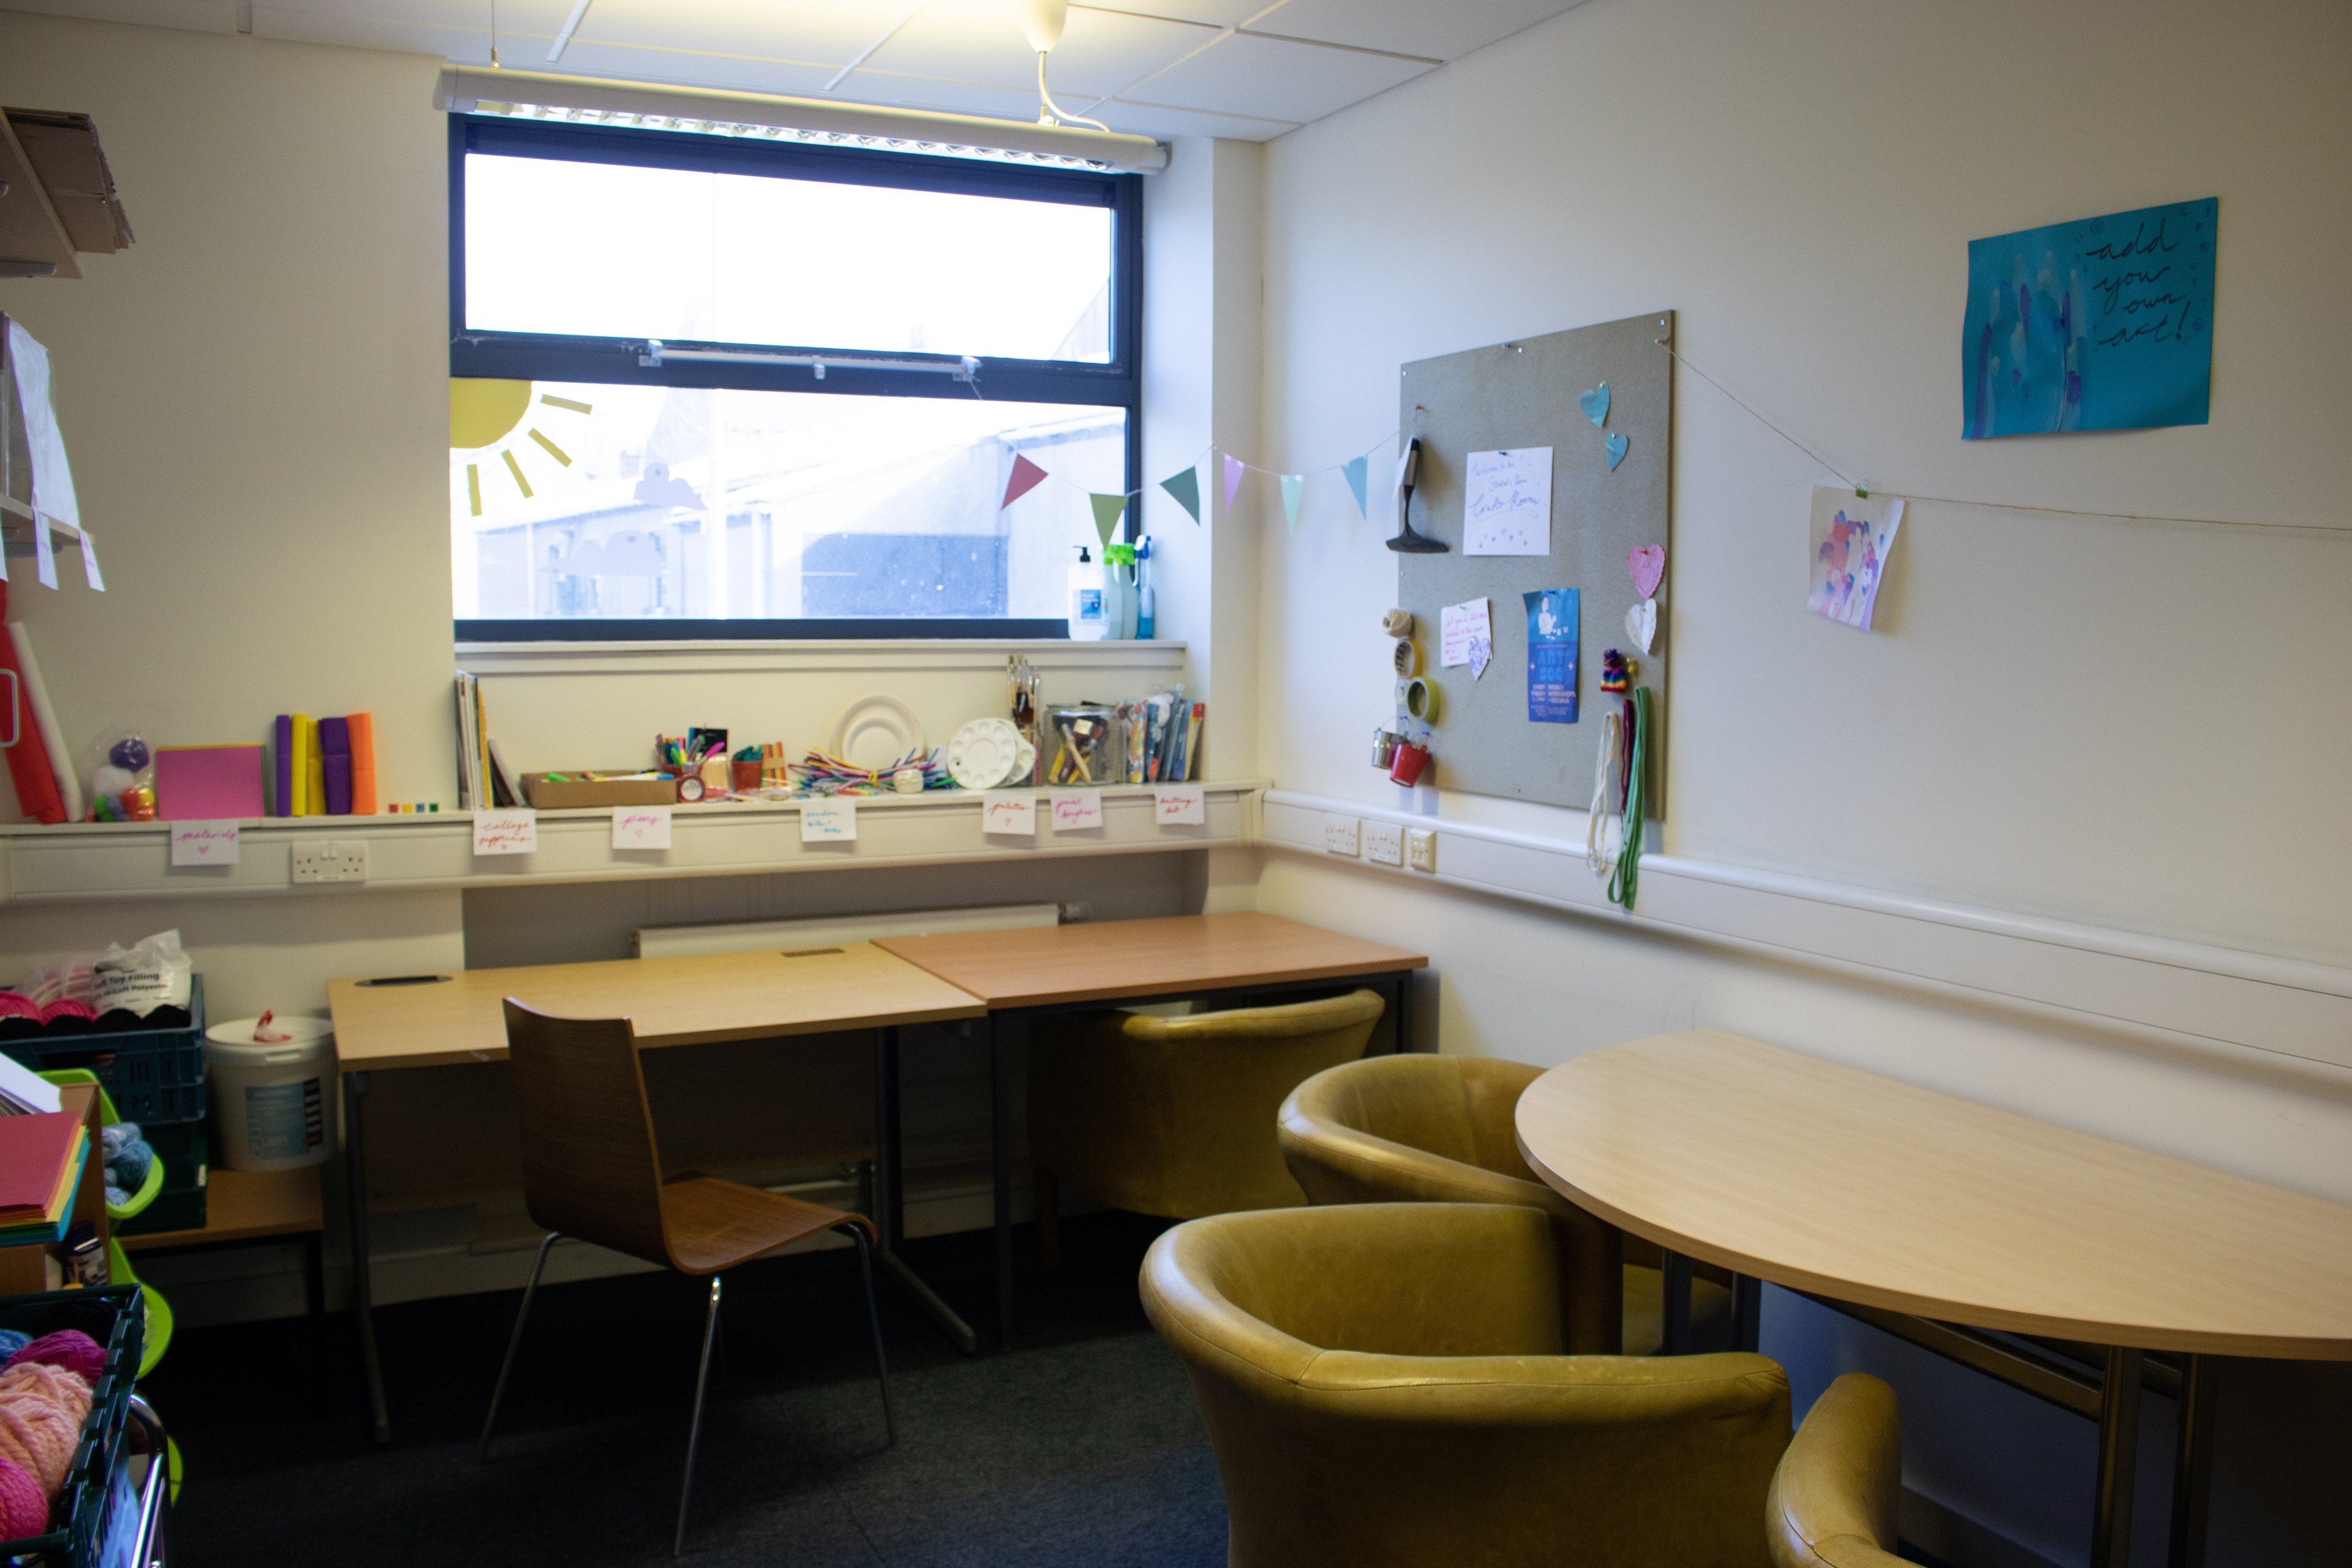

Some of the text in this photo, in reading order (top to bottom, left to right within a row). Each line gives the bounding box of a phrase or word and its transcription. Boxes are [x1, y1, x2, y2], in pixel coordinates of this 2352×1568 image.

[2086, 217, 2181, 260] add
[2092, 266, 2171, 315] your
[2122, 293, 2187, 314] own
[2098, 300, 2192, 347] art!
[479, 820, 529, 836] collage
[618, 813, 663, 831] pens
[175, 827, 236, 842] materials
[108, 976, 126, 985] Toy
